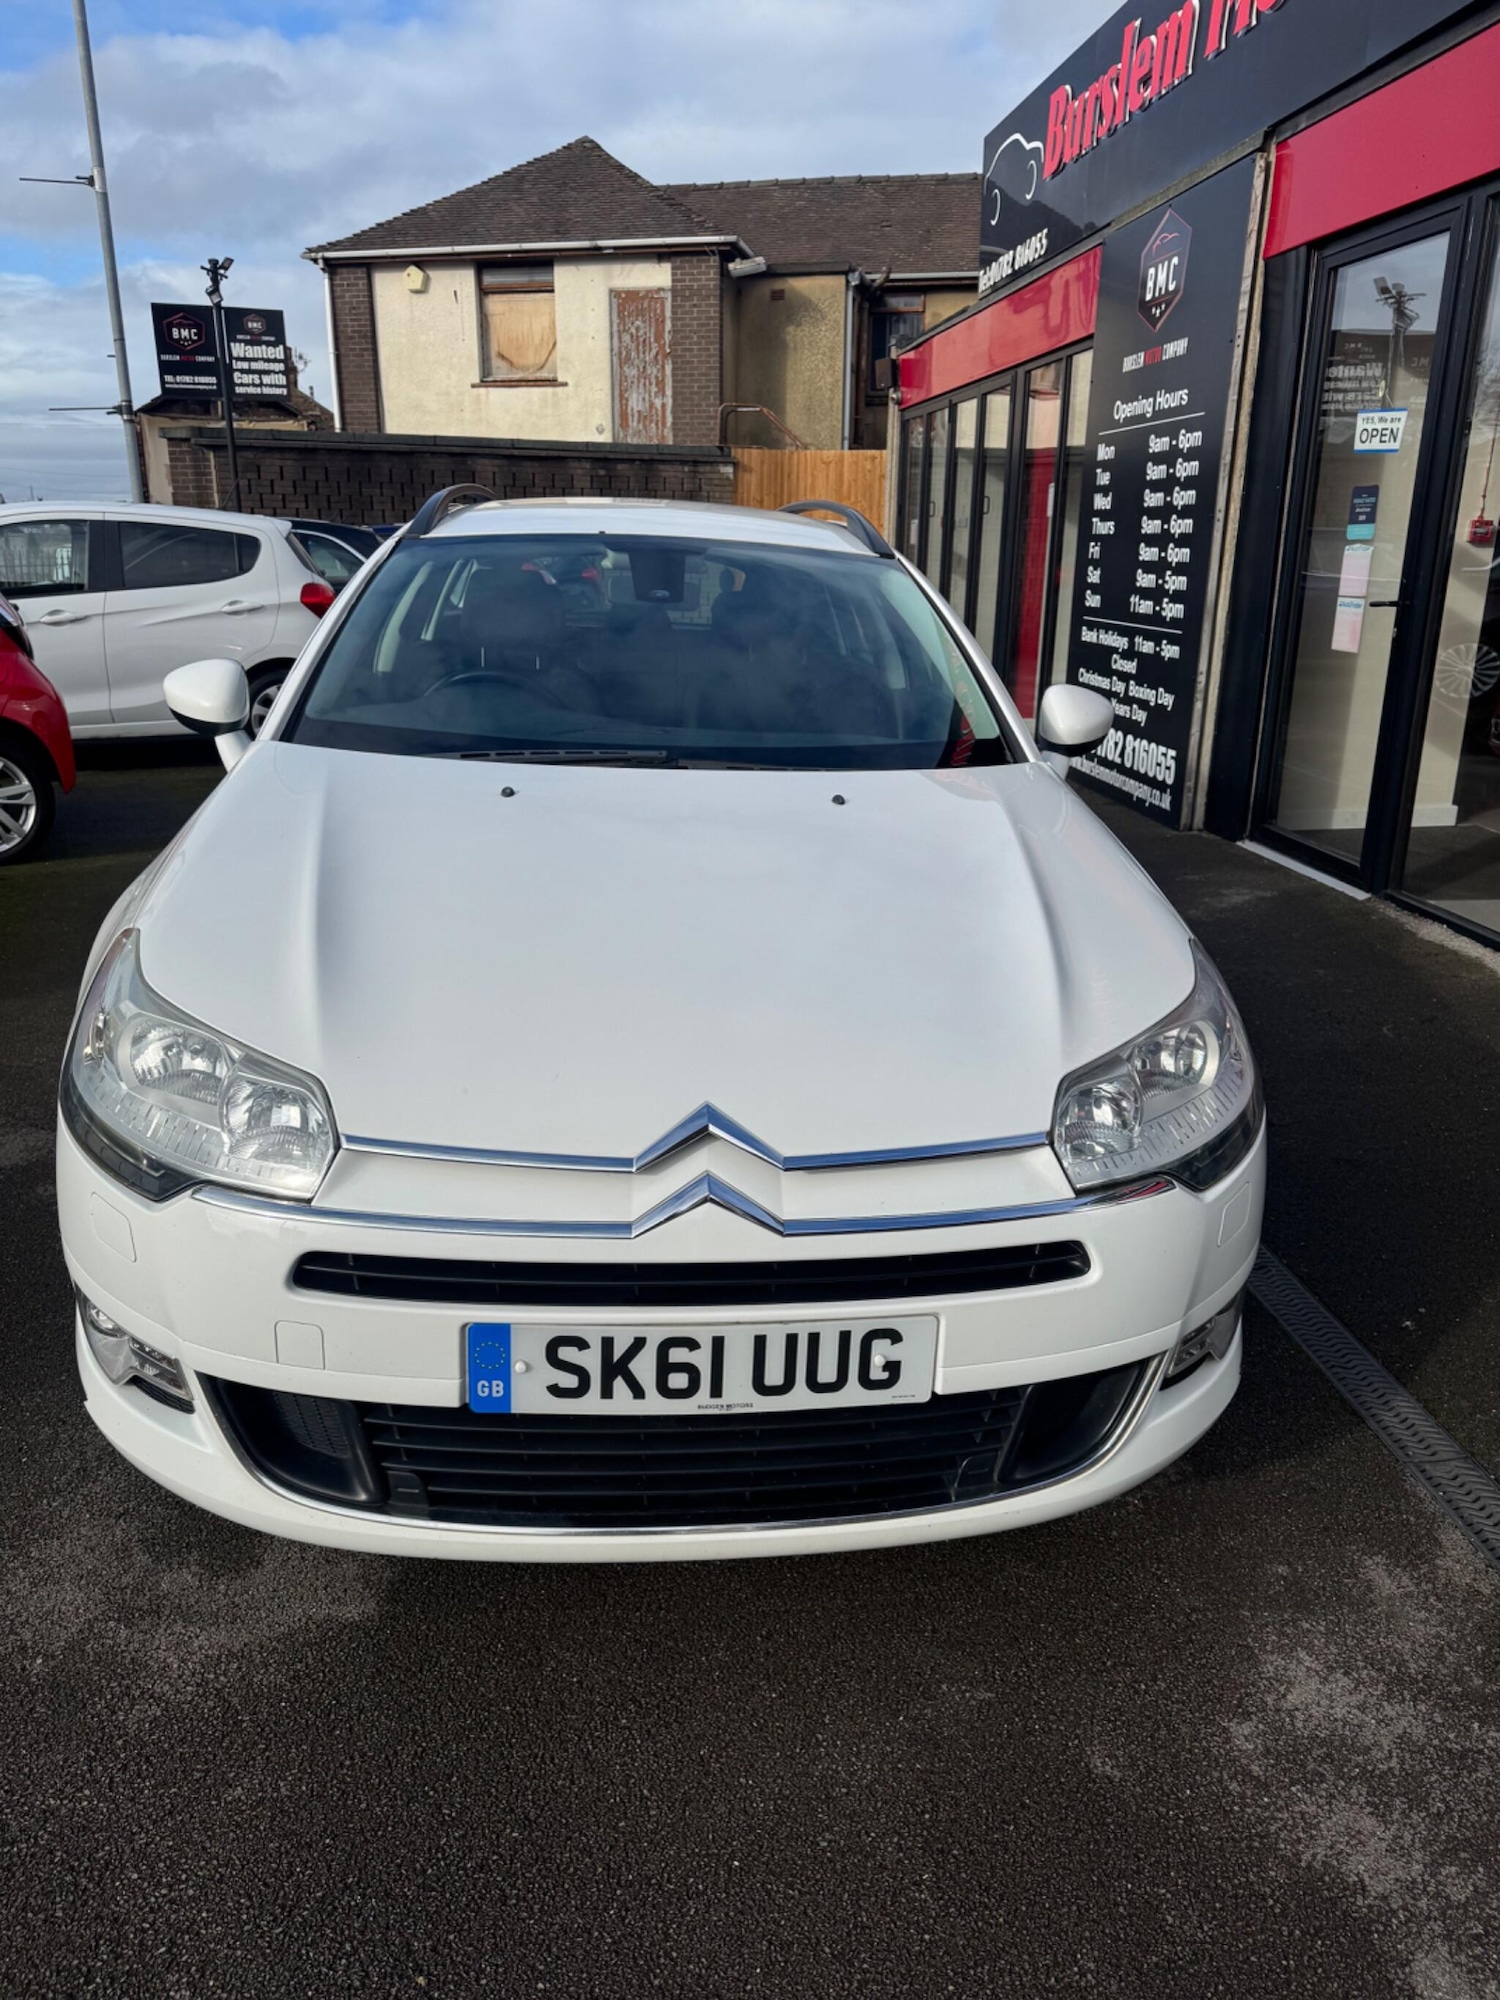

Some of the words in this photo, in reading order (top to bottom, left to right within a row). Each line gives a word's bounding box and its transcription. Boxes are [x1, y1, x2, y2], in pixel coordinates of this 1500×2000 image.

[1043, 0, 1199, 180] Burslem
[1015, 228, 1048, 270] 816055
[1145, 256, 1179, 301] BMC
[171, 327, 198, 340] BMC
[230, 342, 285, 359] Wanted
[1162, 337, 1189, 361] COMPANY
[232, 359, 249, 370] Low
[250, 359, 285, 372] mileage
[233, 371, 260, 384] Cars
[261, 372, 287, 385] with
[234, 385, 261, 395] service
[262, 386, 287, 396] history
[1113, 395, 1154, 423] Opening
[1155, 388, 1189, 411] Hours
[1362, 416, 1377, 426] YES,
[1377, 416, 1387, 424] We
[1389, 415, 1402, 424] are
[1096, 442, 1115, 461] Mon
[1148, 434, 1170, 453] 9am
[1178, 428, 1202, 453] 6pm
[1359, 427, 1400, 444] OPEN
[1096, 468, 1111, 486] Tue
[1146, 461, 1167, 480] 9am
[1175, 457, 1200, 482] 6pm
[1093, 491, 1112, 510] Wed
[1143, 488, 1164, 508] 9am
[1172, 486, 1196, 510] 6pm
[1092, 517, 1115, 535] Thurs
[1141, 515, 1162, 534] 9am
[1169, 514, 1193, 539] 6pm
[1088, 541, 1101, 559] Fri
[1138, 542, 1159, 561] 9am
[1167, 542, 1190, 567] 6pm
[1086, 565, 1101, 584] Sat
[1135, 568, 1156, 588] 9am
[1164, 570, 1187, 594] 5pm
[1085, 589, 1101, 608] Sun
[1129, 594, 1153, 615] 11am
[1161, 597, 1184, 622] 5pm
[1081, 626, 1098, 643] Bank
[1098, 628, 1129, 652] Holidays
[1134, 635, 1155, 654] 11am
[1160, 640, 1180, 661] 5pm
[1111, 653, 1137, 674] Closed
[1078, 667, 1111, 690] Christmas
[1111, 676, 1126, 698] Day
[1128, 680, 1156, 706] Boxing
[1157, 687, 1175, 711] Day
[1111, 697, 1131, 718] Years
[1131, 704, 1148, 727] Day
[1124, 734, 1177, 785] 816055
[544, 1334, 725, 1399] SK61
[752, 1327, 904, 1397] UUG
[476, 1380, 504, 1398] GB
